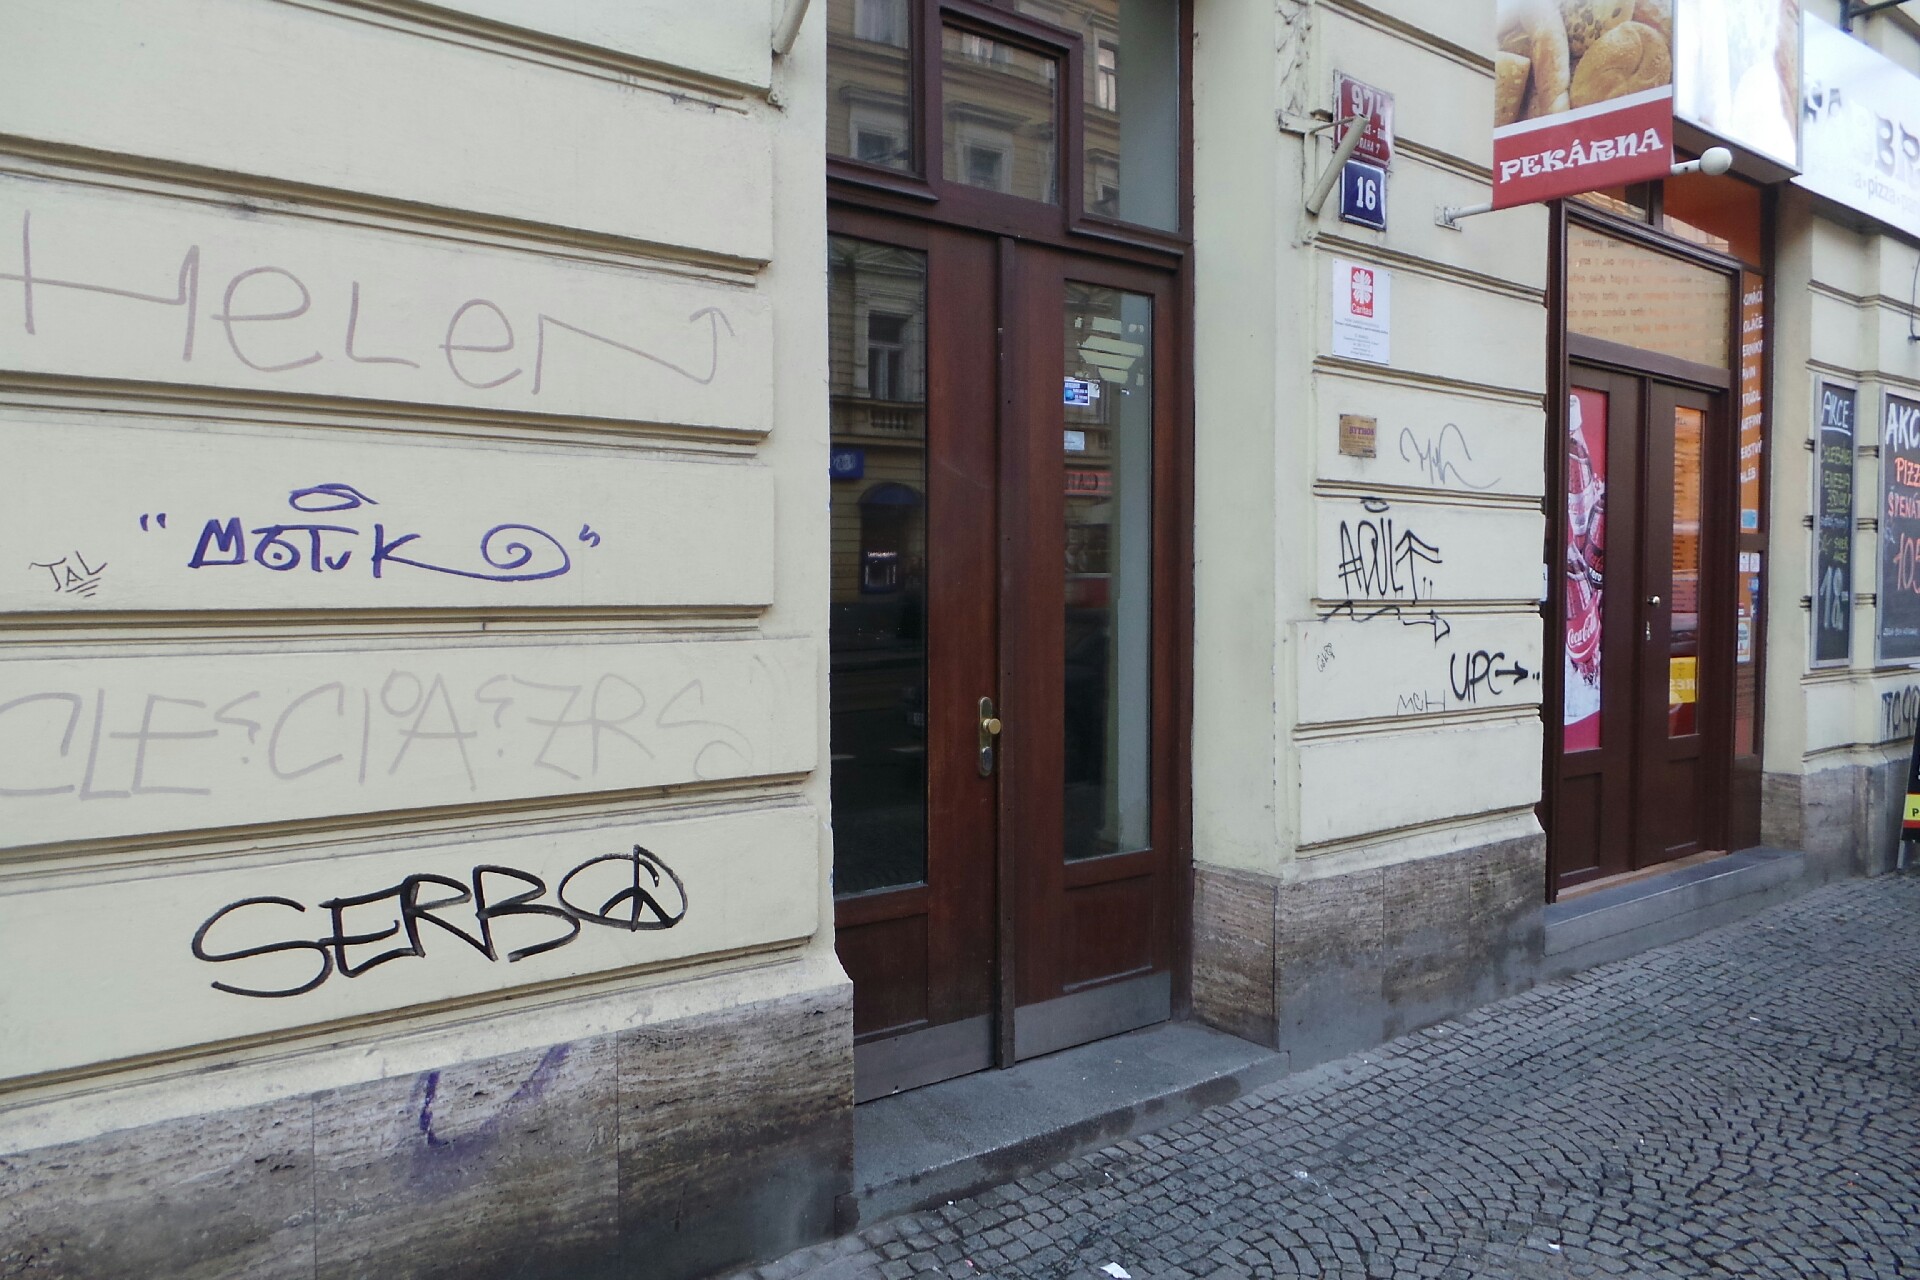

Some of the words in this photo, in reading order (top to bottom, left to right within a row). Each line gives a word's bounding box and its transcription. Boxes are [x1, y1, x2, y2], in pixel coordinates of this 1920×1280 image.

[1499, 127, 1664, 184] PEKÁRNA
[1356, 176, 1377, 211] 16
[1352, 302, 1373, 316] Caritas
[1743, 312, 1763, 333] OLÁČE
[1821, 390, 1850, 428] AKCE
